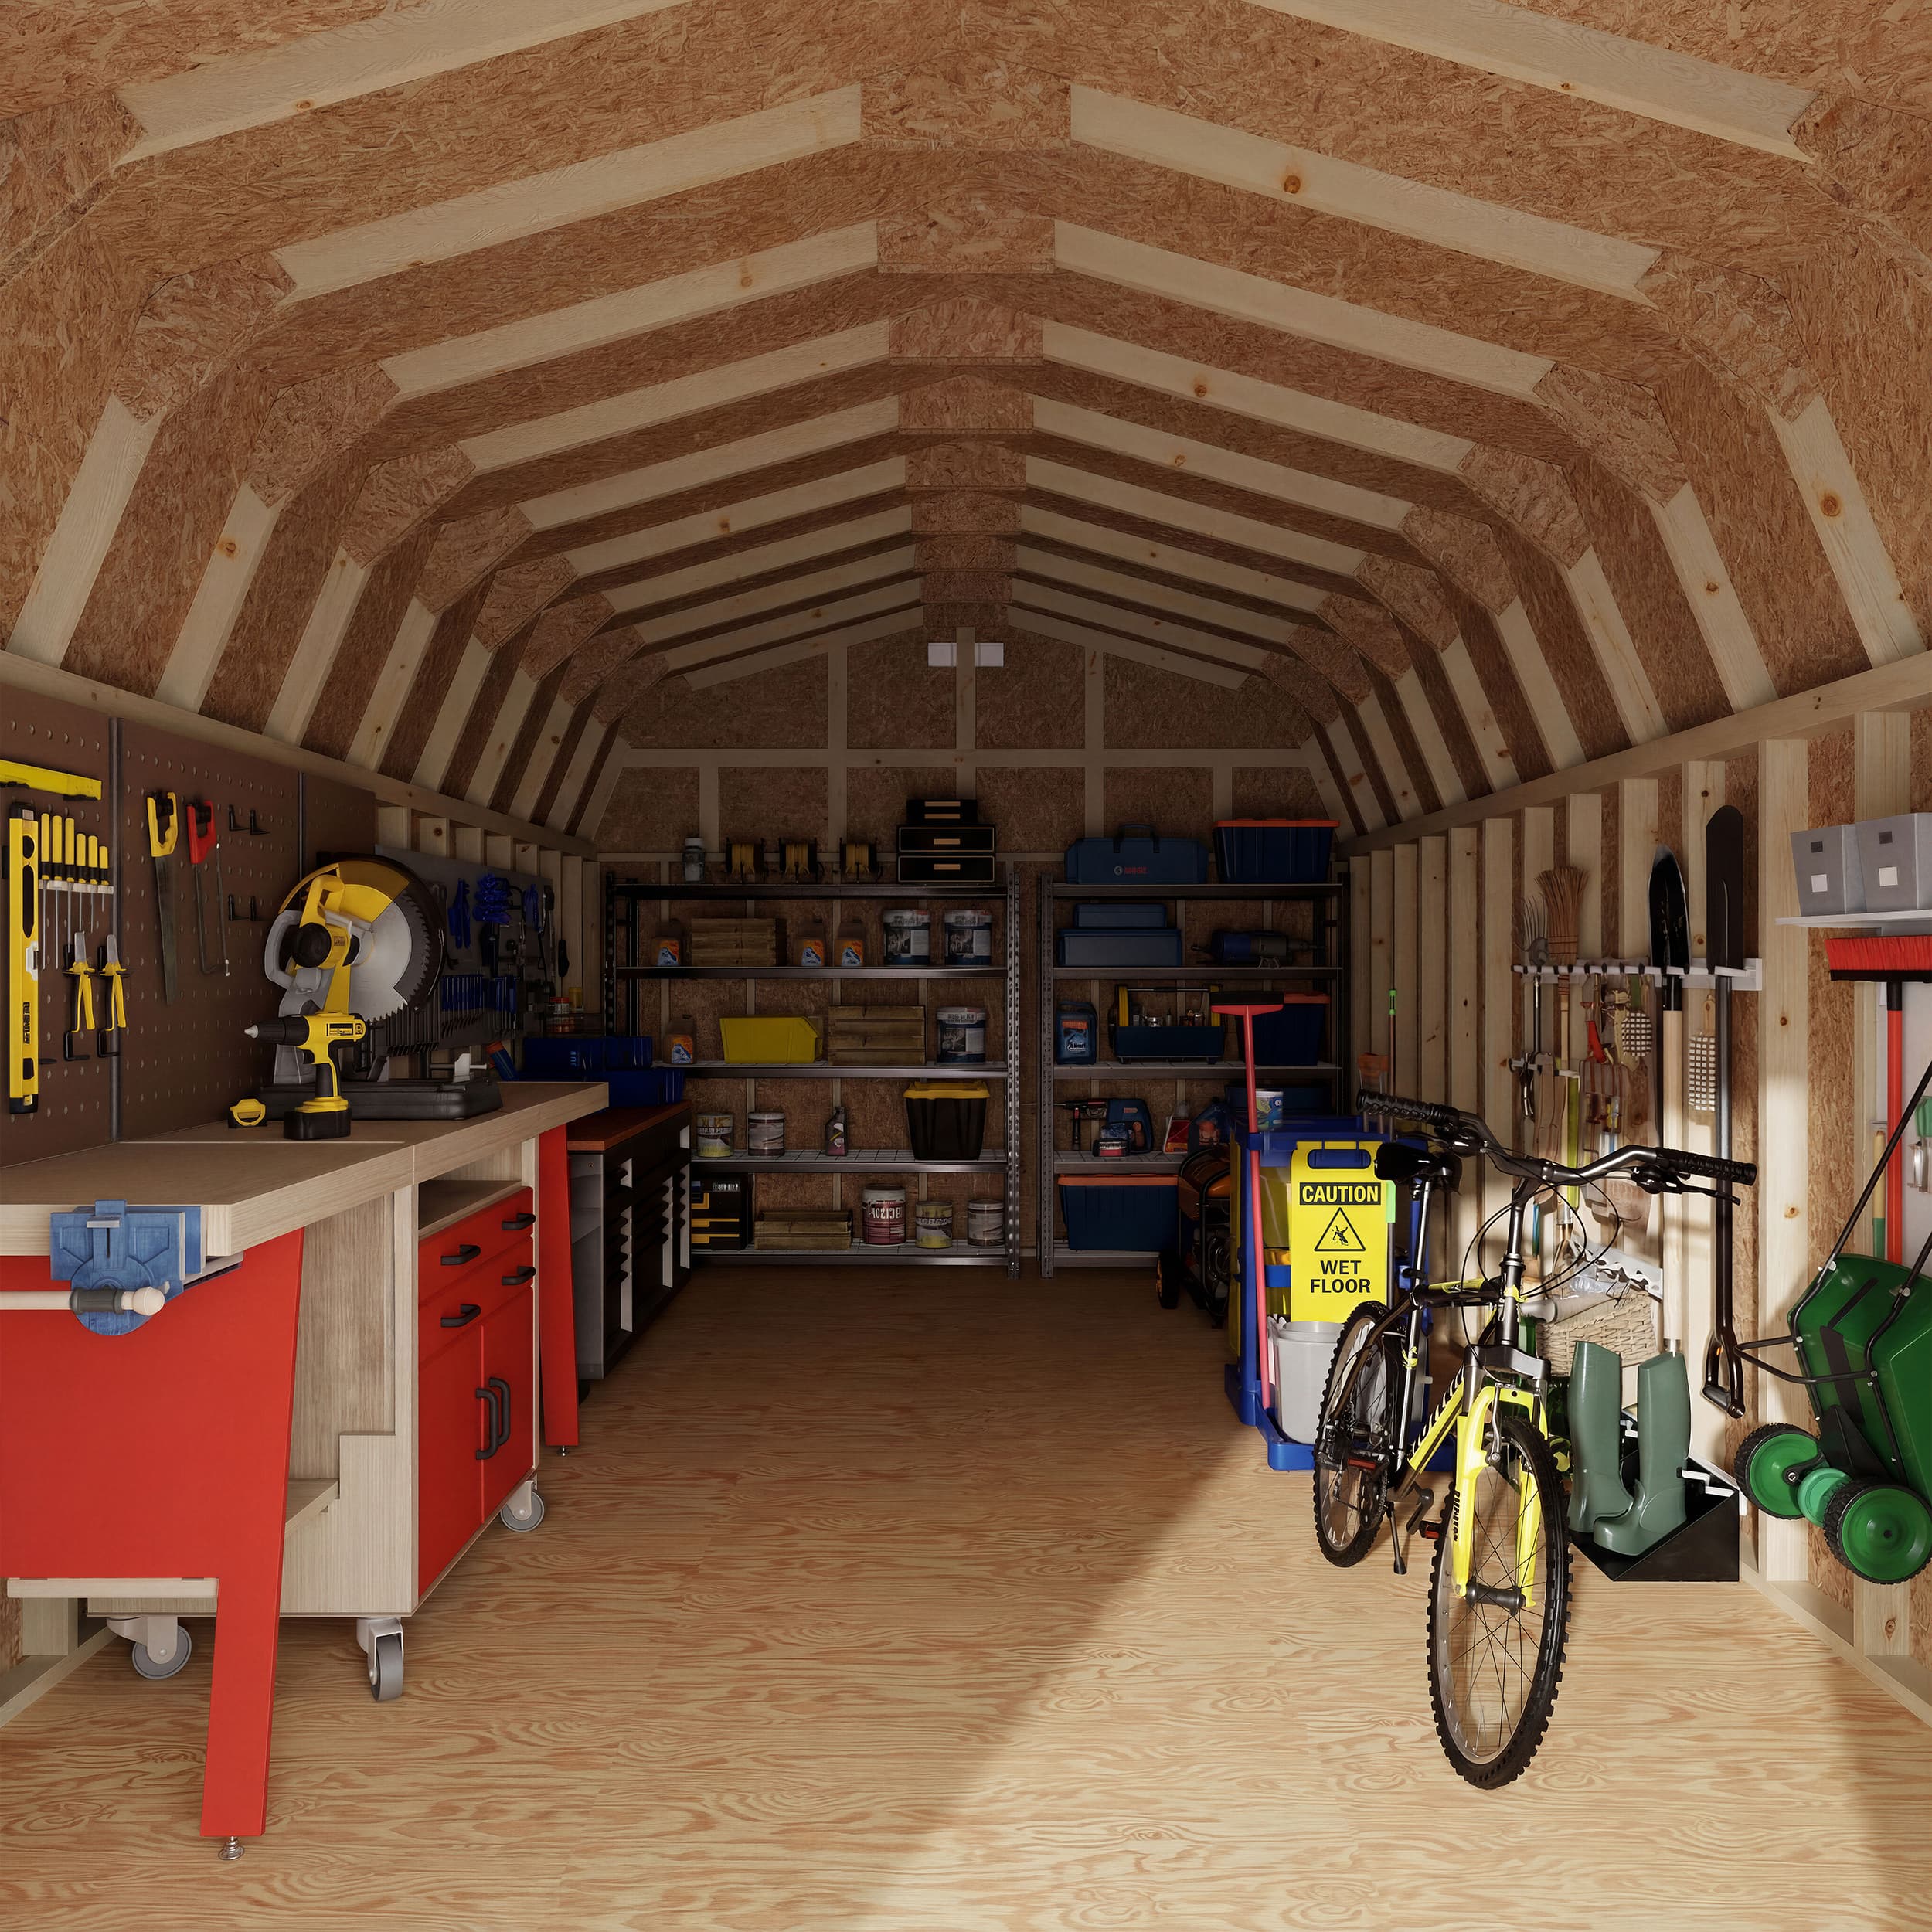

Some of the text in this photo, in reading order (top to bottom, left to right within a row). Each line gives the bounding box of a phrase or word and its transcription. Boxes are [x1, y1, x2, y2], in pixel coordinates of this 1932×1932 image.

[1302, 1185, 1379, 1202] CAUTION
[1320, 1260, 1362, 1275] WET
[1310, 1278, 1371, 1294] FLOOR
